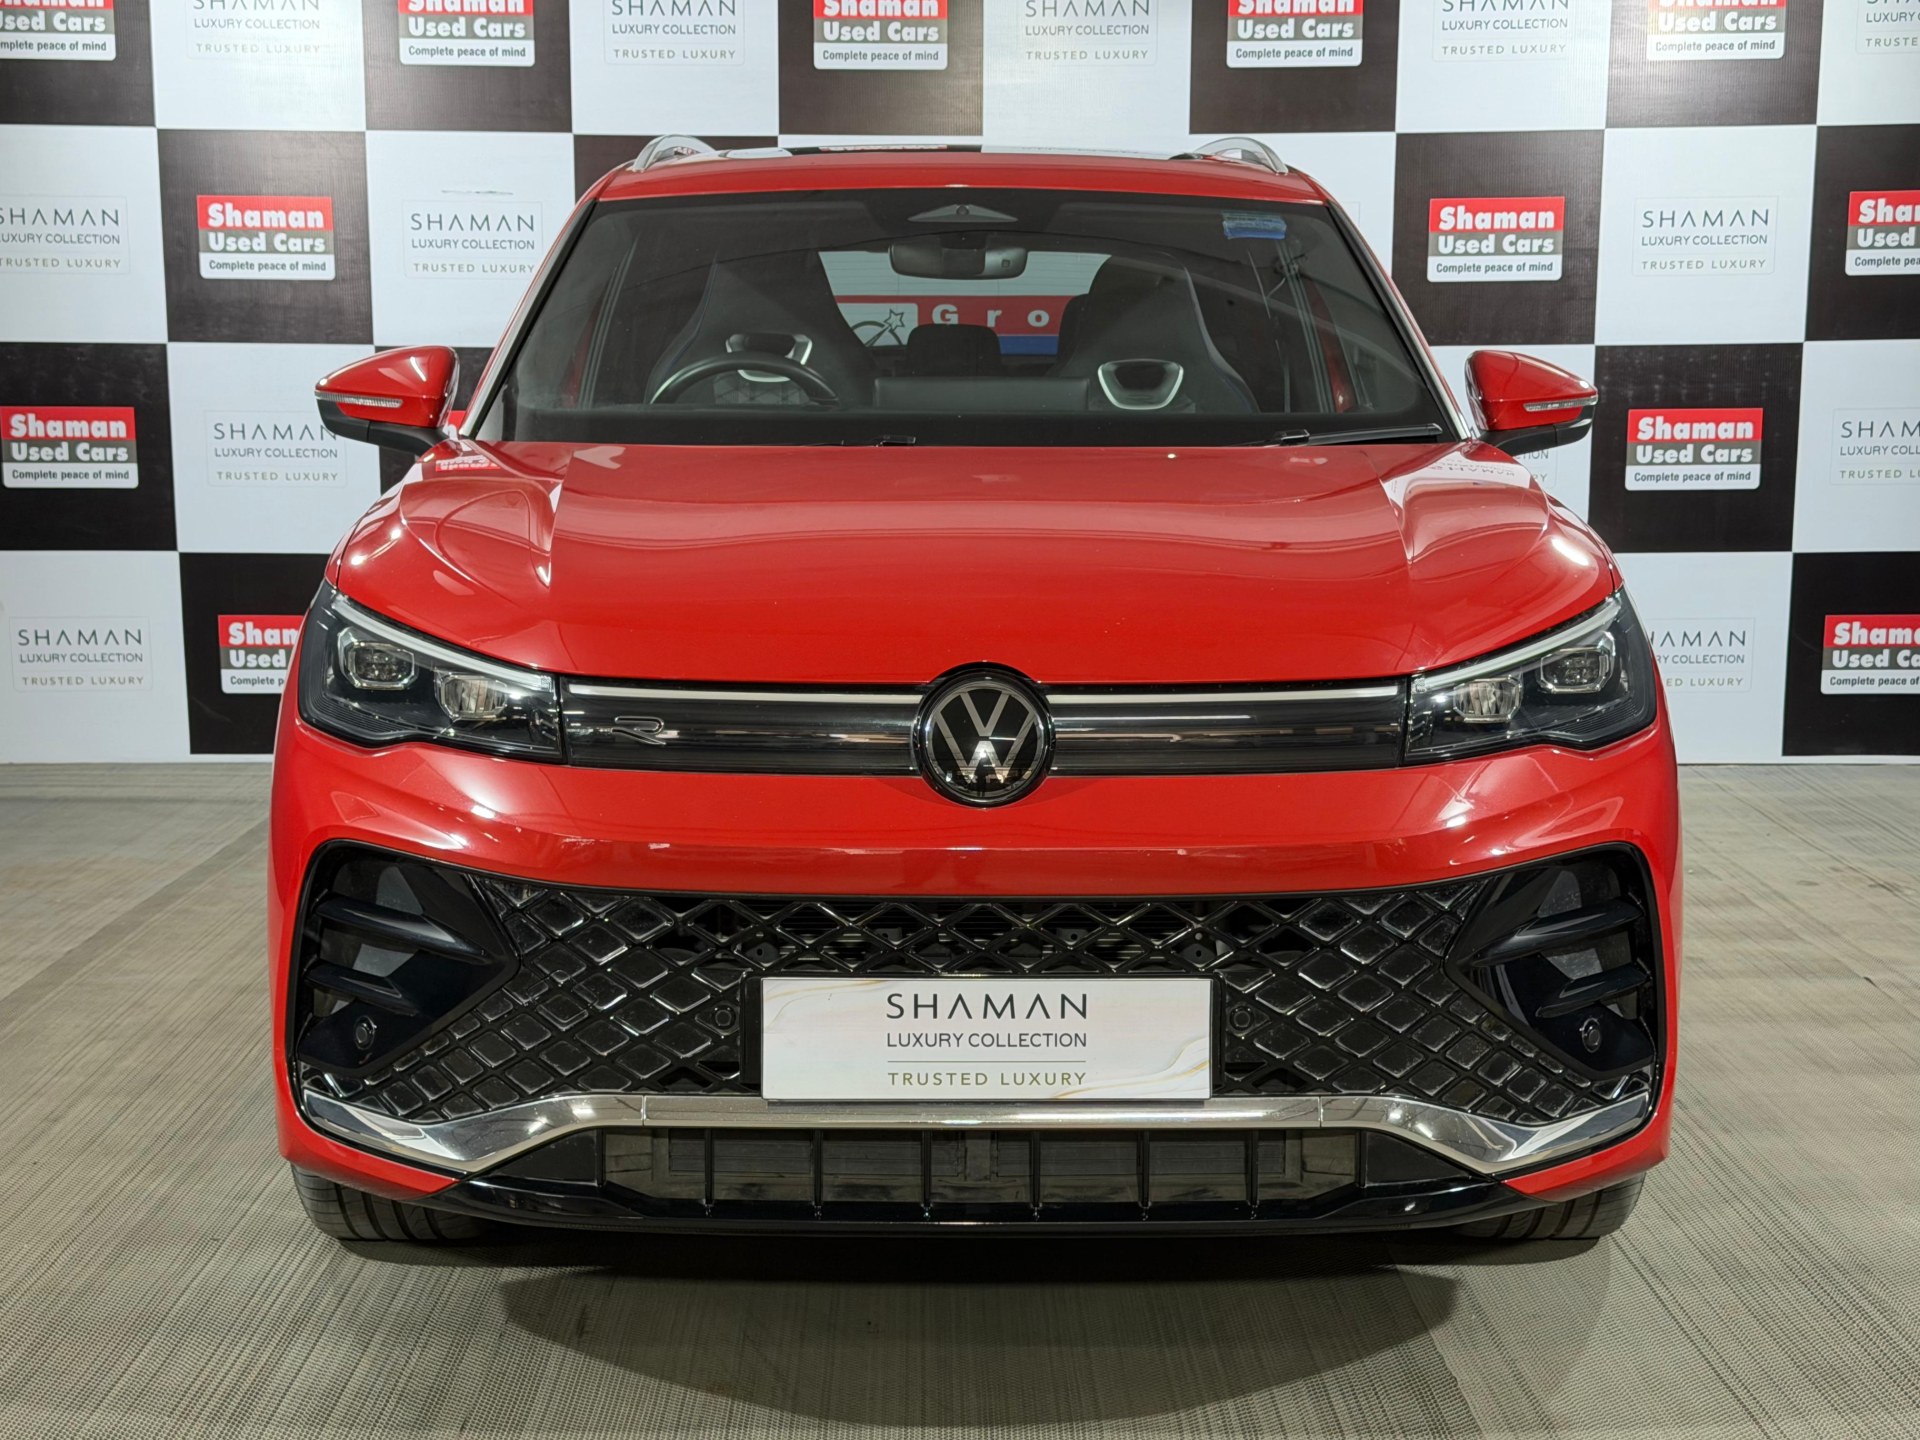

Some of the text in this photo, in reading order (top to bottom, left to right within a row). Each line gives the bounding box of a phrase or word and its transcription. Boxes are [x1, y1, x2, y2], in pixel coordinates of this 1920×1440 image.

[612, 0, 736, 16] SHAMAN
[1025, 0, 1150, 17] SHAMAN
[0, 10, 106, 32] sed Cars
[194, 18, 320, 29] LUXURY COLLECTION
[1658, 11, 1777, 32] Used Cars
[1866, 11, 1915, 23] LUXURY
[408, 16, 526, 37] Used Cars
[612, 24, 736, 35] LUXURY COLLECTION
[823, 21, 939, 41] Used Cars
[1025, 25, 1150, 36] LUXURY COLLECTION
[1237, 18, 1354, 39] Used Cars
[1442, 18, 1568, 31] LUXURY COLLECTION
[0, 41, 107, 52] mplete peace of mind
[196, 43, 320, 53] TRUSTED LUXURY
[1655, 40, 1776, 53] Complete peace of mind
[1865, 37, 1918, 47] TRUSTE
[408, 45, 526, 58] Complete peace of mind
[614, 49, 736, 59] TRUSTED LUXURY
[823, 50, 939, 62] Complete peace of mind
[1026, 50, 1149, 60] TRUSTED LUXURY
[1235, 47, 1353, 60] Complete peace of mind
[1442, 44, 1567, 55] TRUSTED LUXURY
[208, 202, 324, 229] Shaman
[1439, 205, 1555, 230] Shaman
[1858, 198, 1920, 224] Sha
[410, 213, 534, 232] SHAMAN
[1642, 208, 1769, 228] SHAMAN
[0, 233, 120, 244] UXURY COLLECTION
[208, 231, 326, 252] Used Cars
[1438, 233, 1554, 254] Used Cars
[1641, 234, 1768, 247] LUXURY COLLECTION
[1857, 226, 1917, 248] Used
[411, 238, 535, 250] LUXURY COLLECTION
[67, 259, 121, 268] LUXURY
[209, 260, 327, 272] Complete peace of mind
[413, 263, 535, 273] TRUSTED LUXURY
[1436, 262, 1554, 275] Complete peace of mind
[1641, 259, 1766, 270] TRUSTED LUXURY
[1854, 256, 1920, 268] Complete pea
[10, 413, 127, 438] Shaman
[213, 422, 337, 441] SHAMAN
[1637, 416, 1754, 440] Shaman
[1841, 420, 1920, 438] SHAM
[11, 441, 129, 462] Used Cars
[214, 447, 338, 459] LUXURY COLLECTION
[1636, 443, 1753, 463] Used Cars
[1840, 445, 1889, 456] LUXURY
[12, 469, 130, 481] Complete peace of mind
[216, 471, 338, 482] TRUSTED LUXURY
[1634, 471, 1751, 483] Complete peace of mind
[1840, 469, 1902, 479] TRUSTED
[18, 629, 142, 646] SHAMAN
[228, 621, 298, 646] Sham
[1651, 630, 1746, 647] AMAN
[1833, 621, 1920, 645] Sham
[20, 653, 143, 663] LUXURY COLLECTION
[229, 649, 286, 668] Used
[1672, 655, 1745, 664] COLLECTION
[1832, 649, 1920, 668] Used Ca
[22, 676, 144, 686] TRUSTED LUXURY
[230, 676, 275, 687] Complete
[1690, 678, 1743, 686] LUXURY
[1830, 676, 1875, 687] Complete
[1878, 677, 1907, 687] peace
[886, 993, 1087, 1020] SHAMAN
[887, 1033, 1087, 1048] LUXURY COLLECTION
[888, 1072, 1086, 1086] TRUSTED LUXURY
